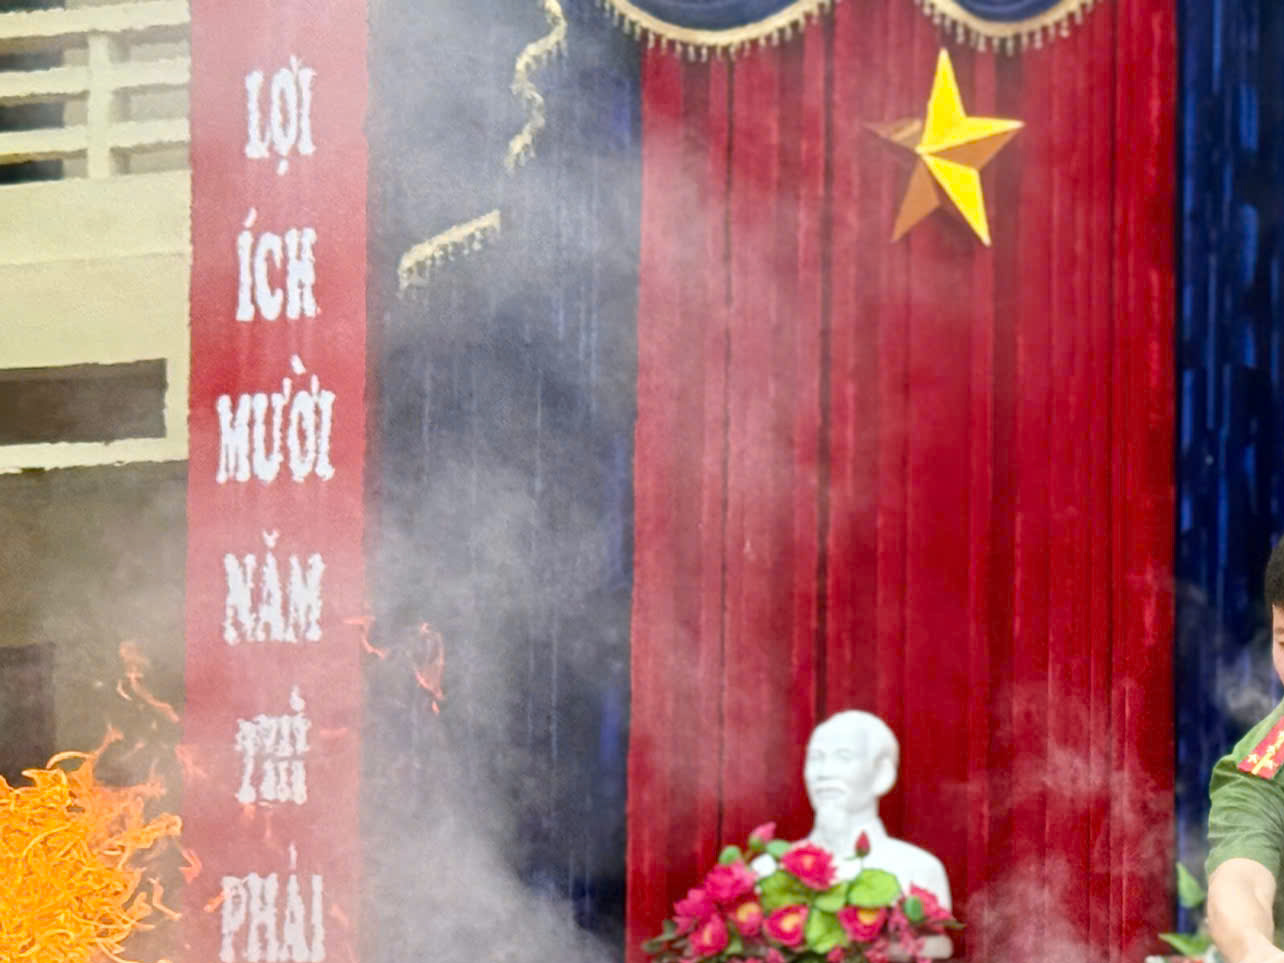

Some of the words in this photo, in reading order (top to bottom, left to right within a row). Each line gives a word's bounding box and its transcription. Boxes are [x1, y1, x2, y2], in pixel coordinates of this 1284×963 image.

[244, 54, 318, 177] LỢI
[235, 206, 320, 322] ÍCH
[215, 355, 336, 483] MƯỜI
[222, 530, 326, 646] NĂM
